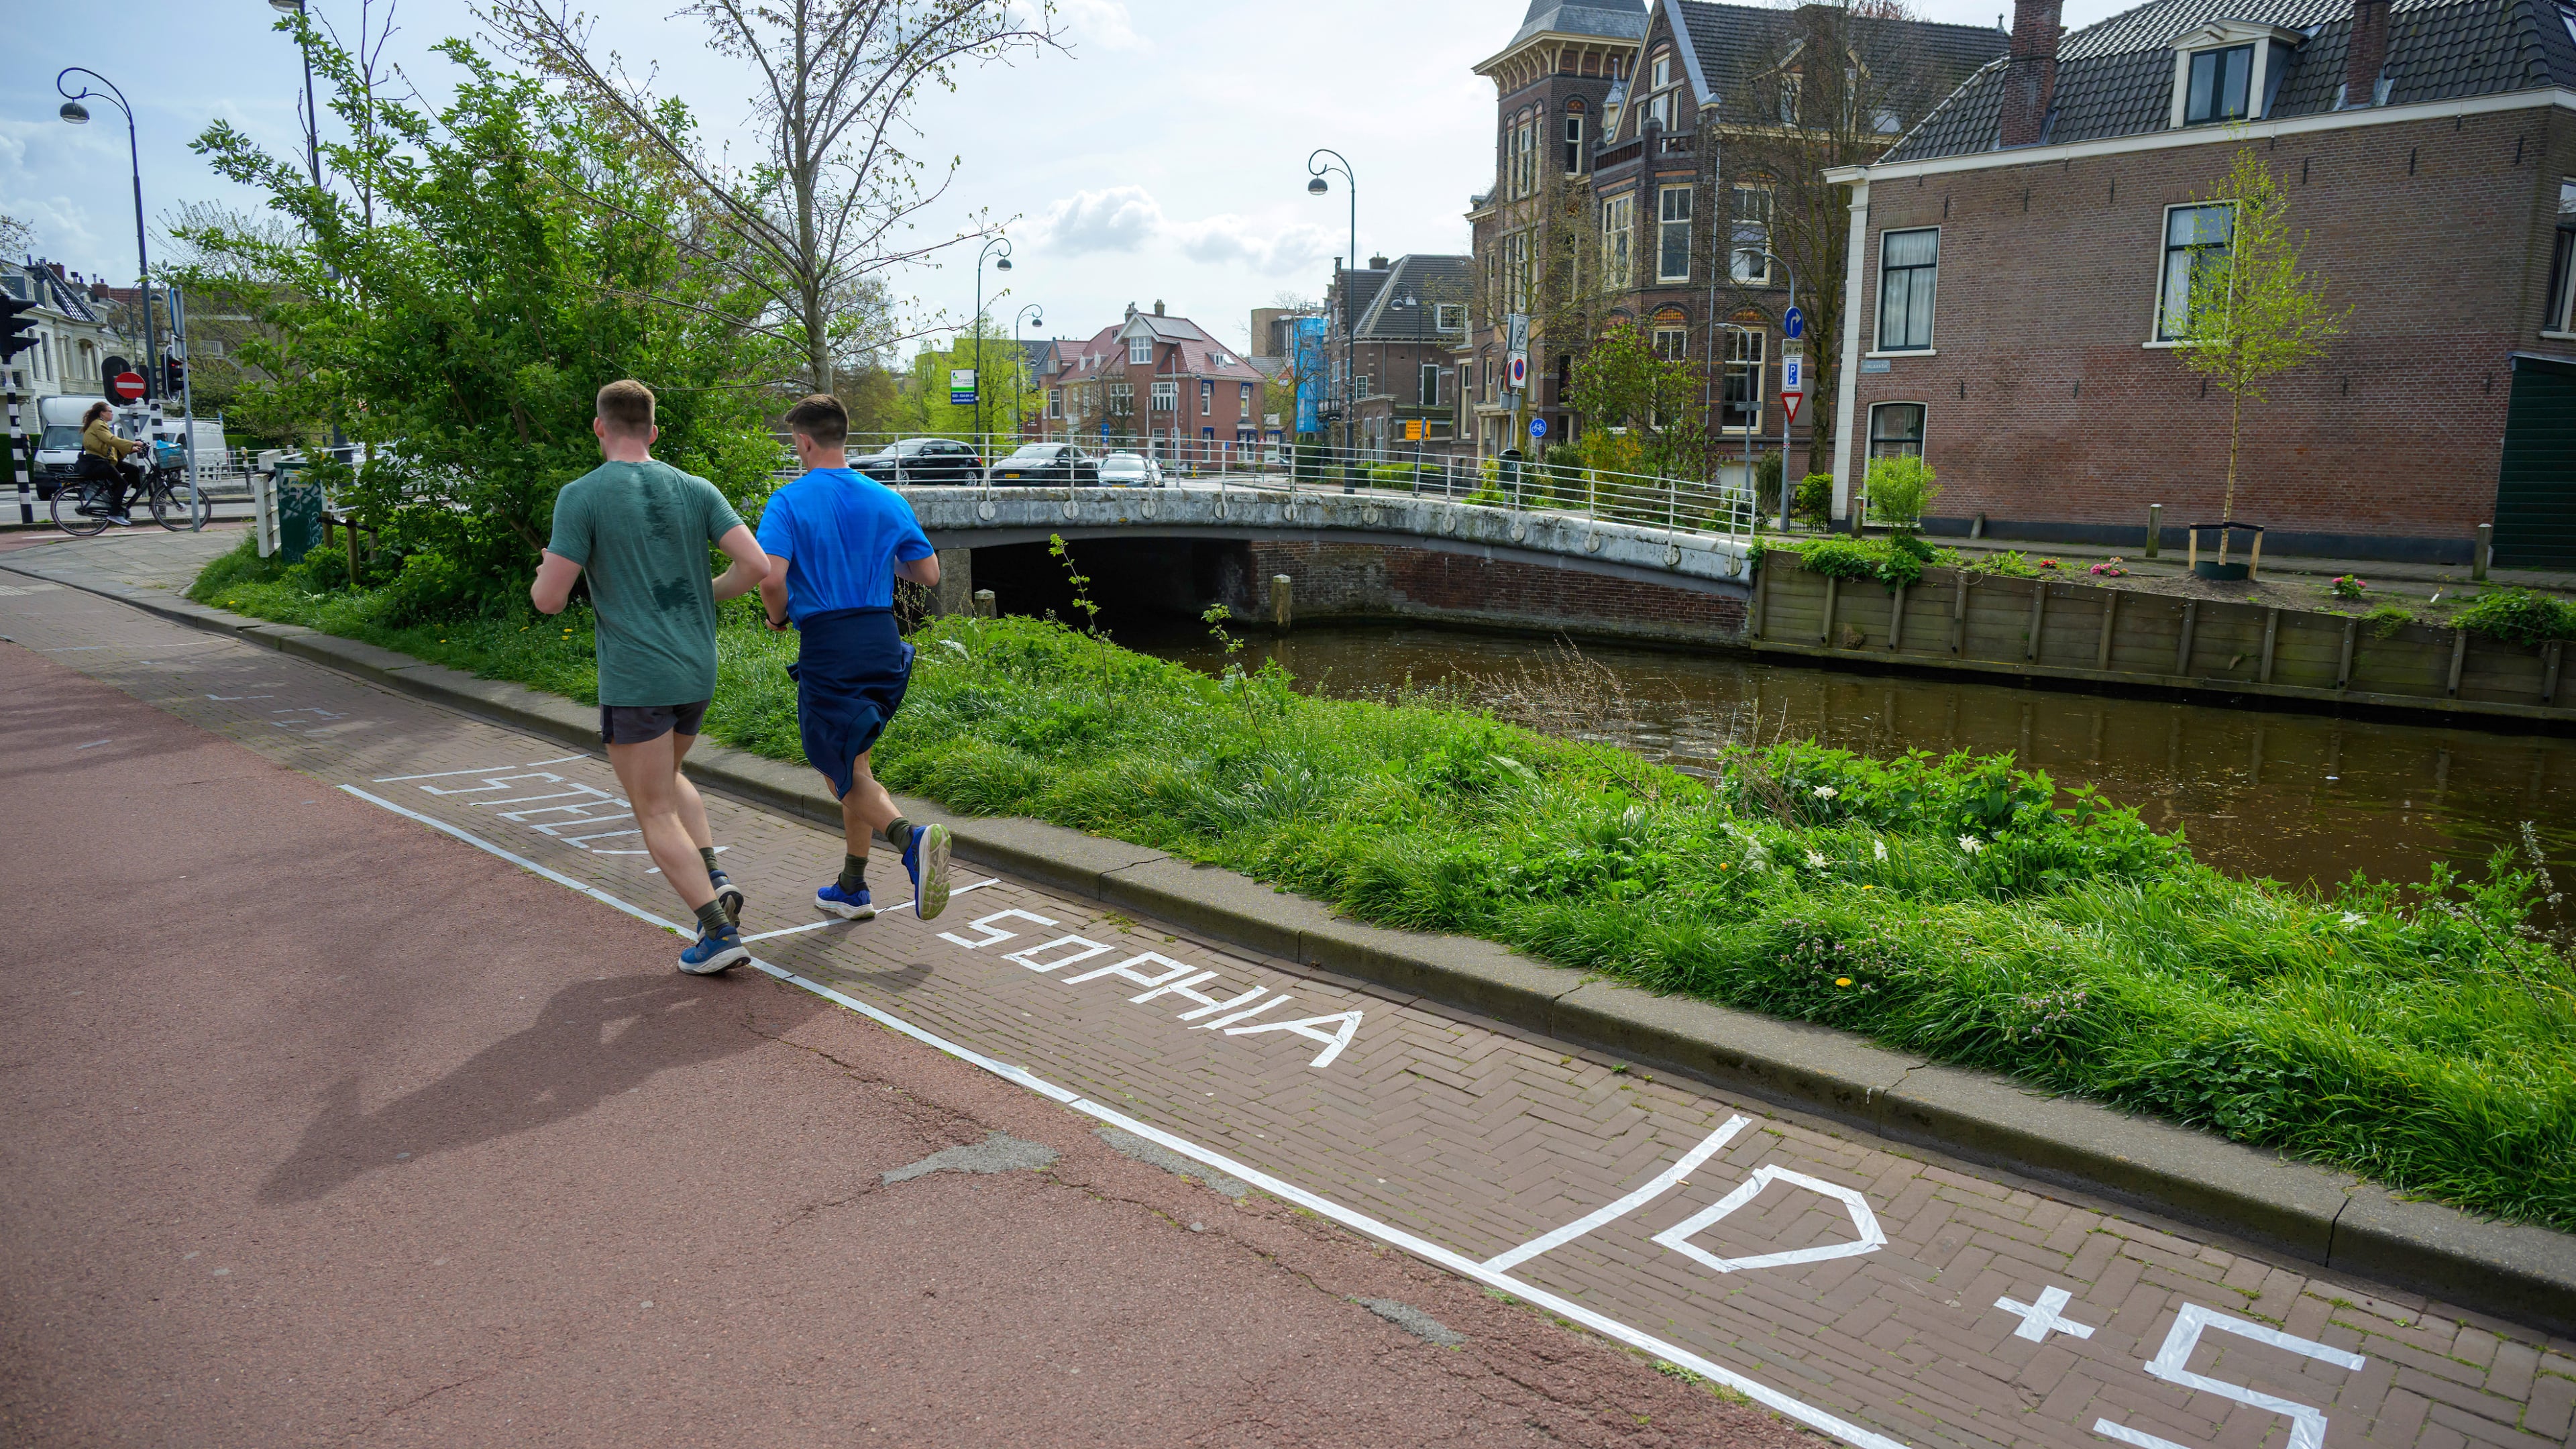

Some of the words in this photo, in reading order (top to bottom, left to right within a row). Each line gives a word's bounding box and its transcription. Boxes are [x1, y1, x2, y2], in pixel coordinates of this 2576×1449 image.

[1518, 330, 1525, 339] 30
[1790, 365, 1796, 376] P
[936, 908, 1364, 1068] SOPHIA
[1651, 1164, 1888, 1273] D
